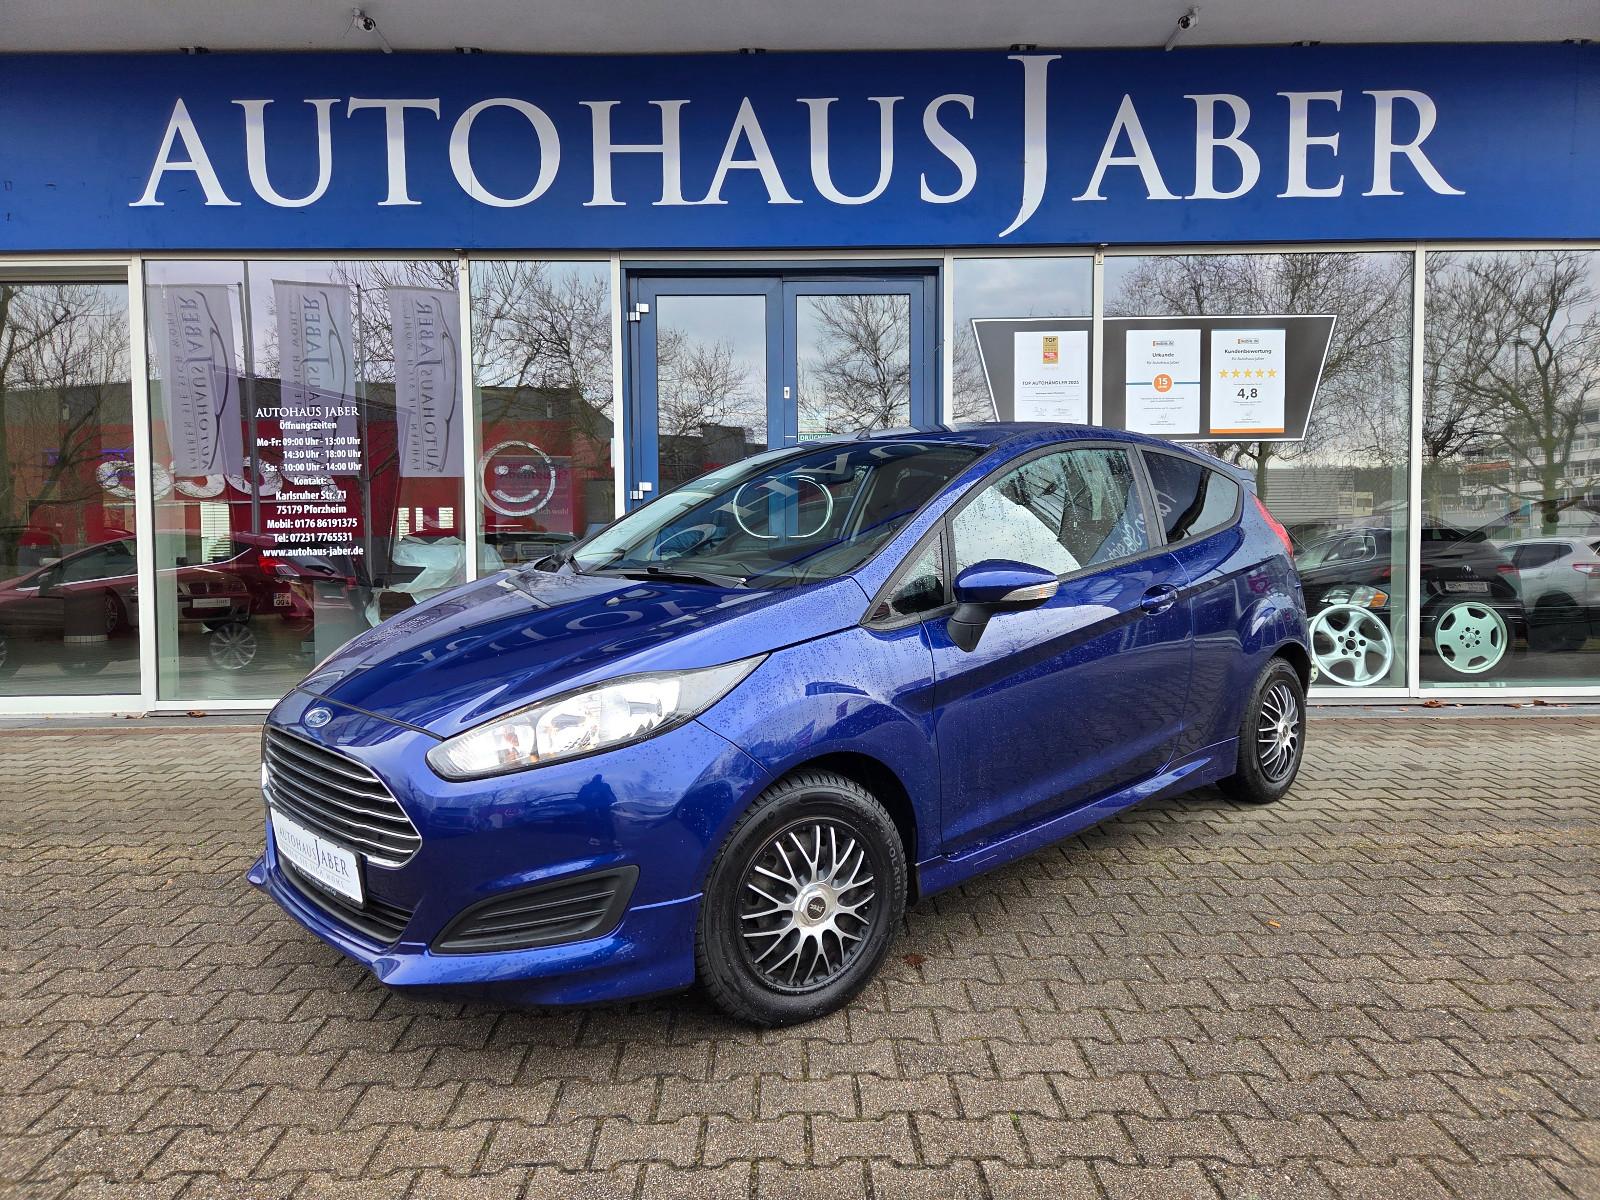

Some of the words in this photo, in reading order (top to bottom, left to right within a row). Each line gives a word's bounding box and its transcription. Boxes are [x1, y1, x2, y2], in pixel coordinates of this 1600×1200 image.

[128, 95, 978, 208] AUTOHAUS
[998, 54, 1466, 238] JABER
[1158, 377, 1168, 385] 15
[1237, 387, 1258, 400] 4,8
[255, 407, 322, 418] AUTOHAUS
[325, 406, 360, 419] JABER
[279, 419, 337, 431] Öffnungszeiten
[256, 438, 282, 447] Mo-Fr:
[283, 438, 304, 446] 09:00
[305, 438, 319, 446] Uhr
[325, 437, 345, 445] 13:00
[347, 436, 361, 445] Uhr
[283, 450, 304, 459] 14:30
[306, 450, 319, 458] Uhr
[325, 450, 346, 458] 18:00
[347, 449, 361, 458] Uhr
[265, 463, 278, 472] Sa:
[284, 463, 304, 472] 10:00
[306, 463, 320, 471] Uhr
[325, 463, 346, 471] 14:00
[348, 462, 362, 470] Uhr
[293, 476, 327, 486] Kontakt:
[276, 491, 319, 501] Karlsruher
[321, 490, 336, 500] Str.
[337, 490, 347, 500] 71
[276, 505, 303, 514] 75179
[304, 504, 347, 514] Pforzheim
[266, 519, 294, 529] Mobil:
[294, 518, 316, 528] 0176
[317, 518, 358, 528] 86191375
[273, 533, 289, 543] Tel:
[290, 533, 315, 543] 07231
[317, 532, 353, 542] 7765531
[263, 546, 364, 557] www.autohaus-jaber.de
